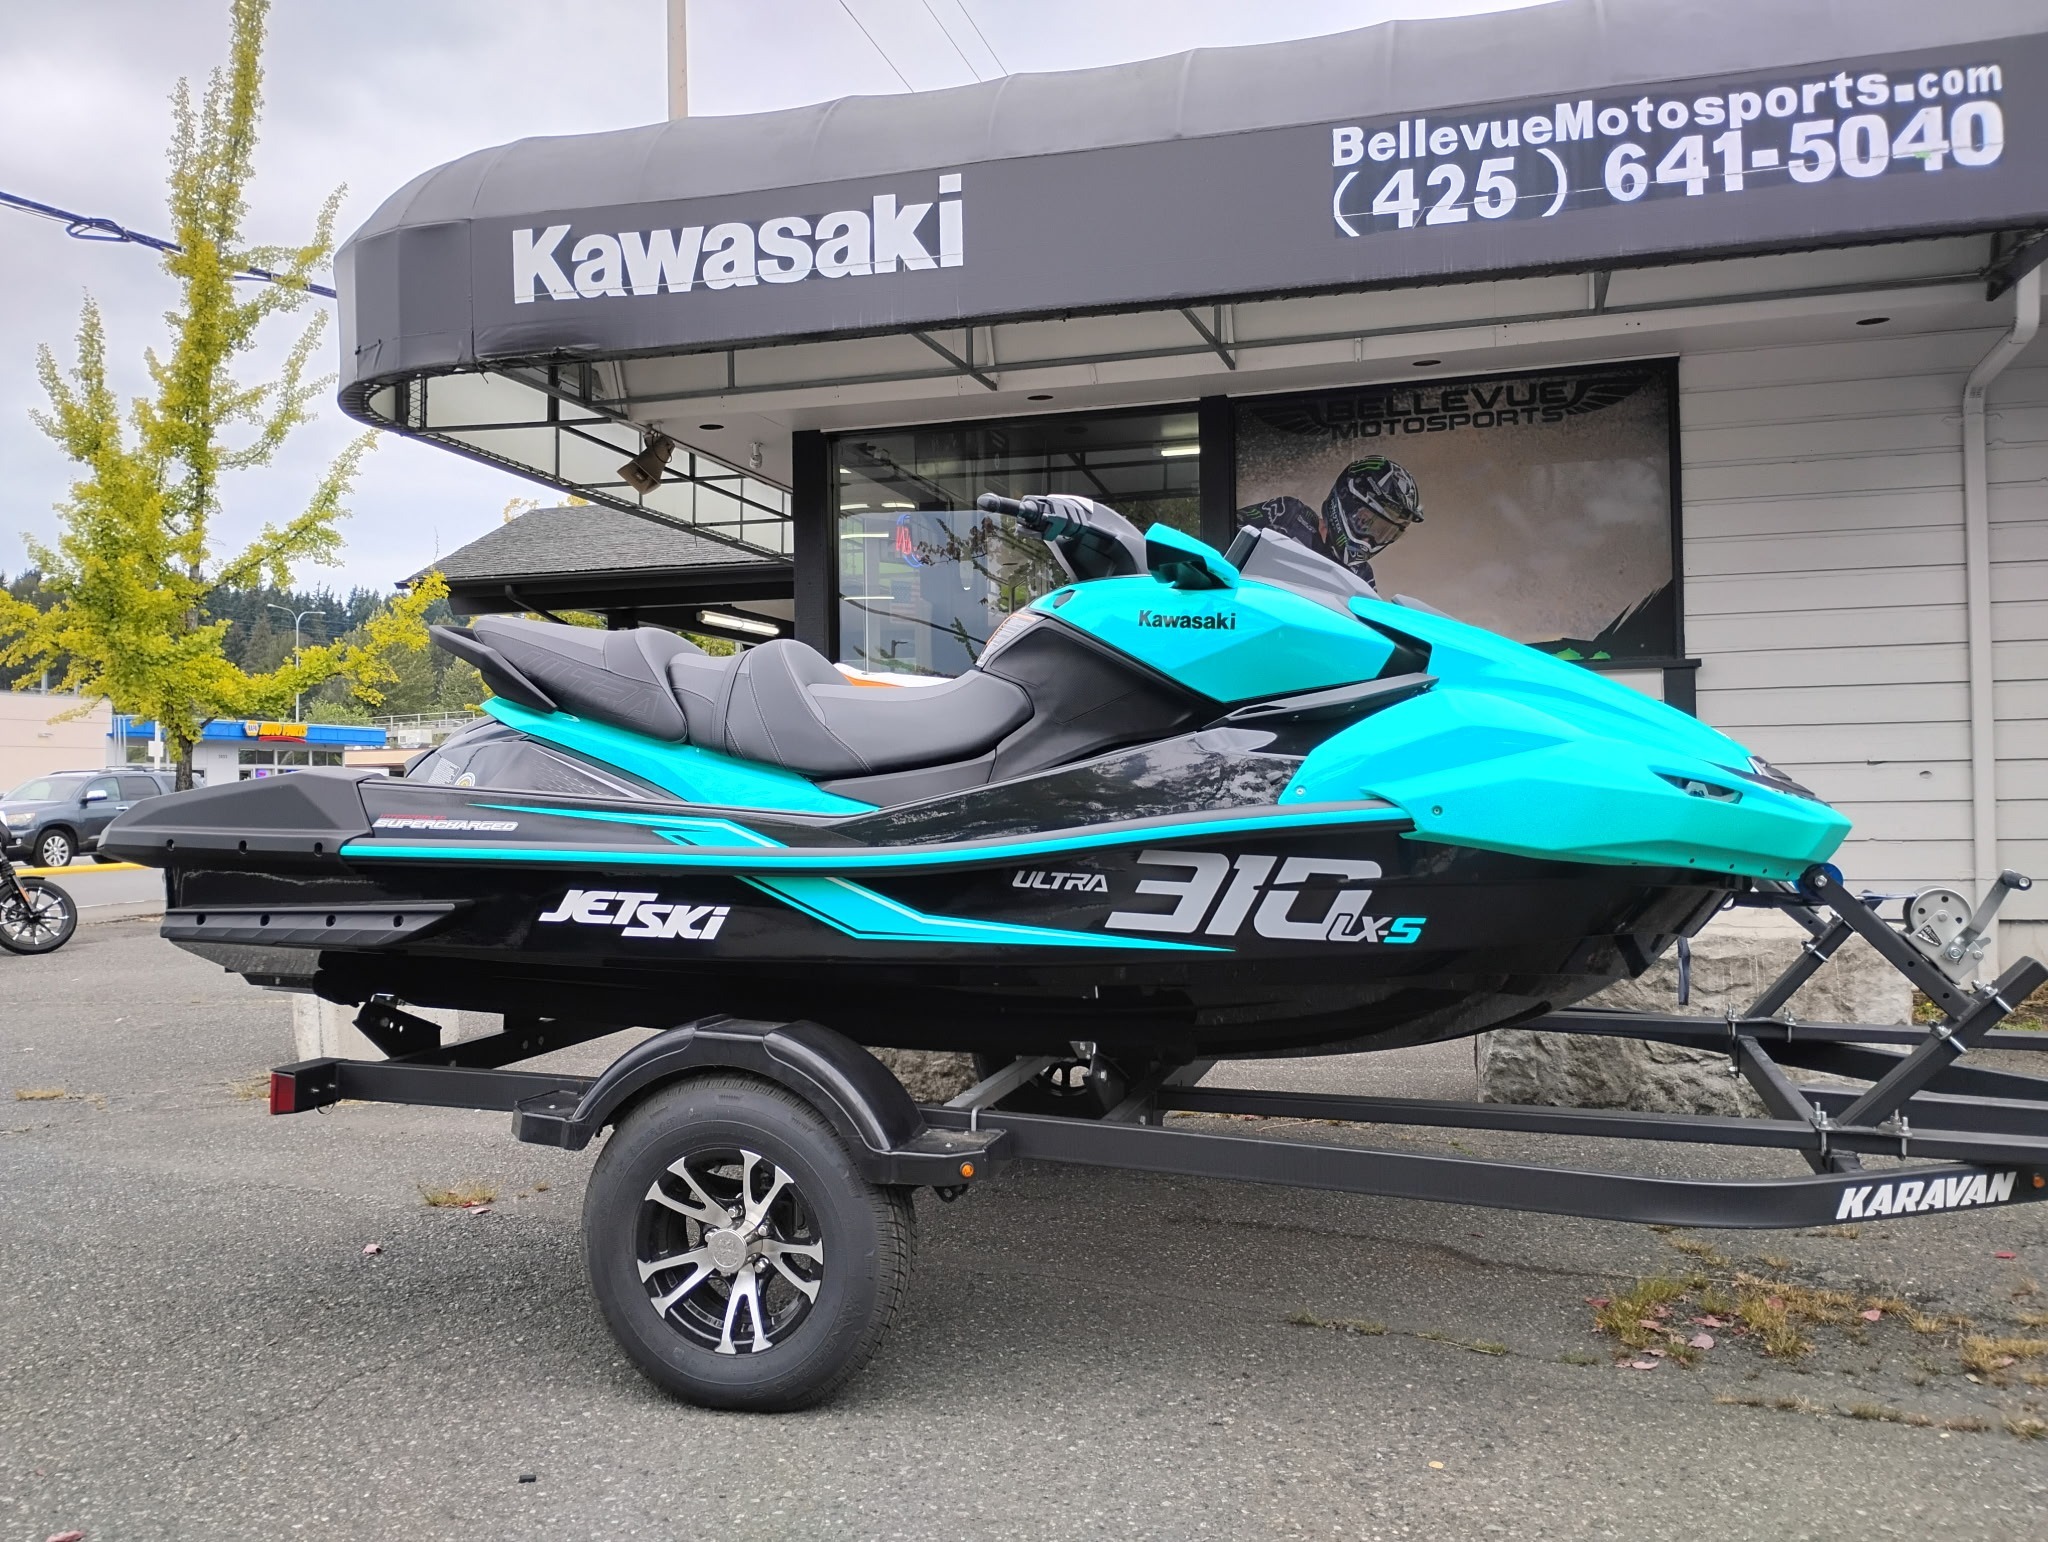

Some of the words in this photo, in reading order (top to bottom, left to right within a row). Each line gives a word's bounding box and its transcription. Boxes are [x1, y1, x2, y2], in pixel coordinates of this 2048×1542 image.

[1332, 63, 2002, 167] BellevueMotosports.com
[1604, 99, 2005, 202] 641-5040
[512, 173, 964, 305] Kawasaki
[1326, 380, 1569, 423] BELLEVUE
[1330, 405, 1564, 441] MOTOSPORTS
[1138, 610, 1236, 630] Kawasaki
[372, 818, 519, 832] SUPERCHARGED
[1012, 870, 1109, 893] ULTRA
[1104, 849, 1383, 941] 310
[1836, 1171, 2017, 1220] KARAVAN
